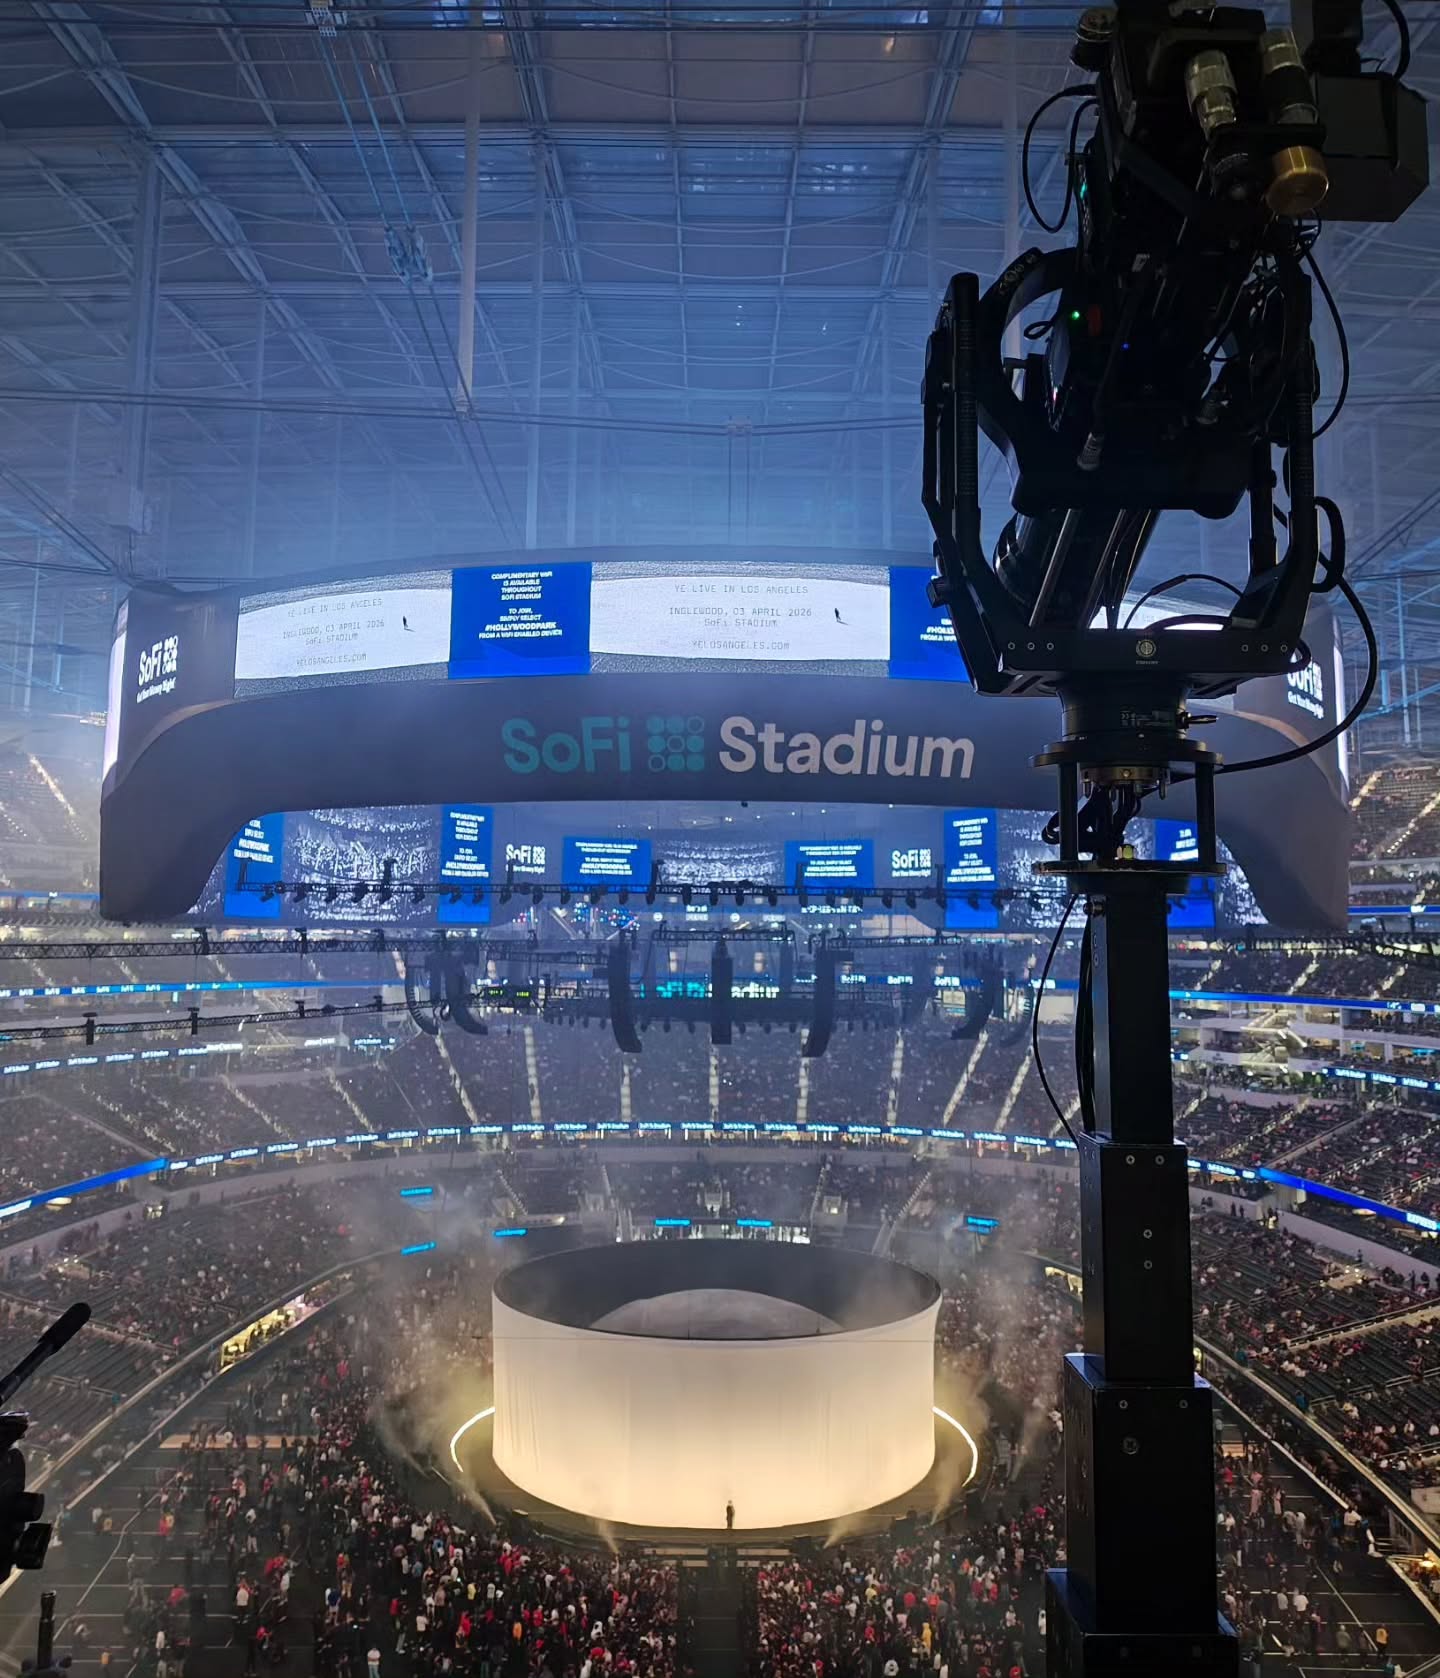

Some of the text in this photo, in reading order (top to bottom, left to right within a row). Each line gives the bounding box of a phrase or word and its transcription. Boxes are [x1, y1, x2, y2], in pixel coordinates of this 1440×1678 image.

[674, 584, 809, 594] YE LIVE IN LOS ANGELES
[669, 607, 812, 617] INGLEWOOD, 03 APRIL 2026
[485, 622, 557, 631] #HOLLYWOODPARK
[735, 618, 778, 628] STADIUM
[138, 640, 163, 687] SoFi
[501, 714, 975, 779] SoFi Stadium
[891, 849, 919, 869] SoFi
